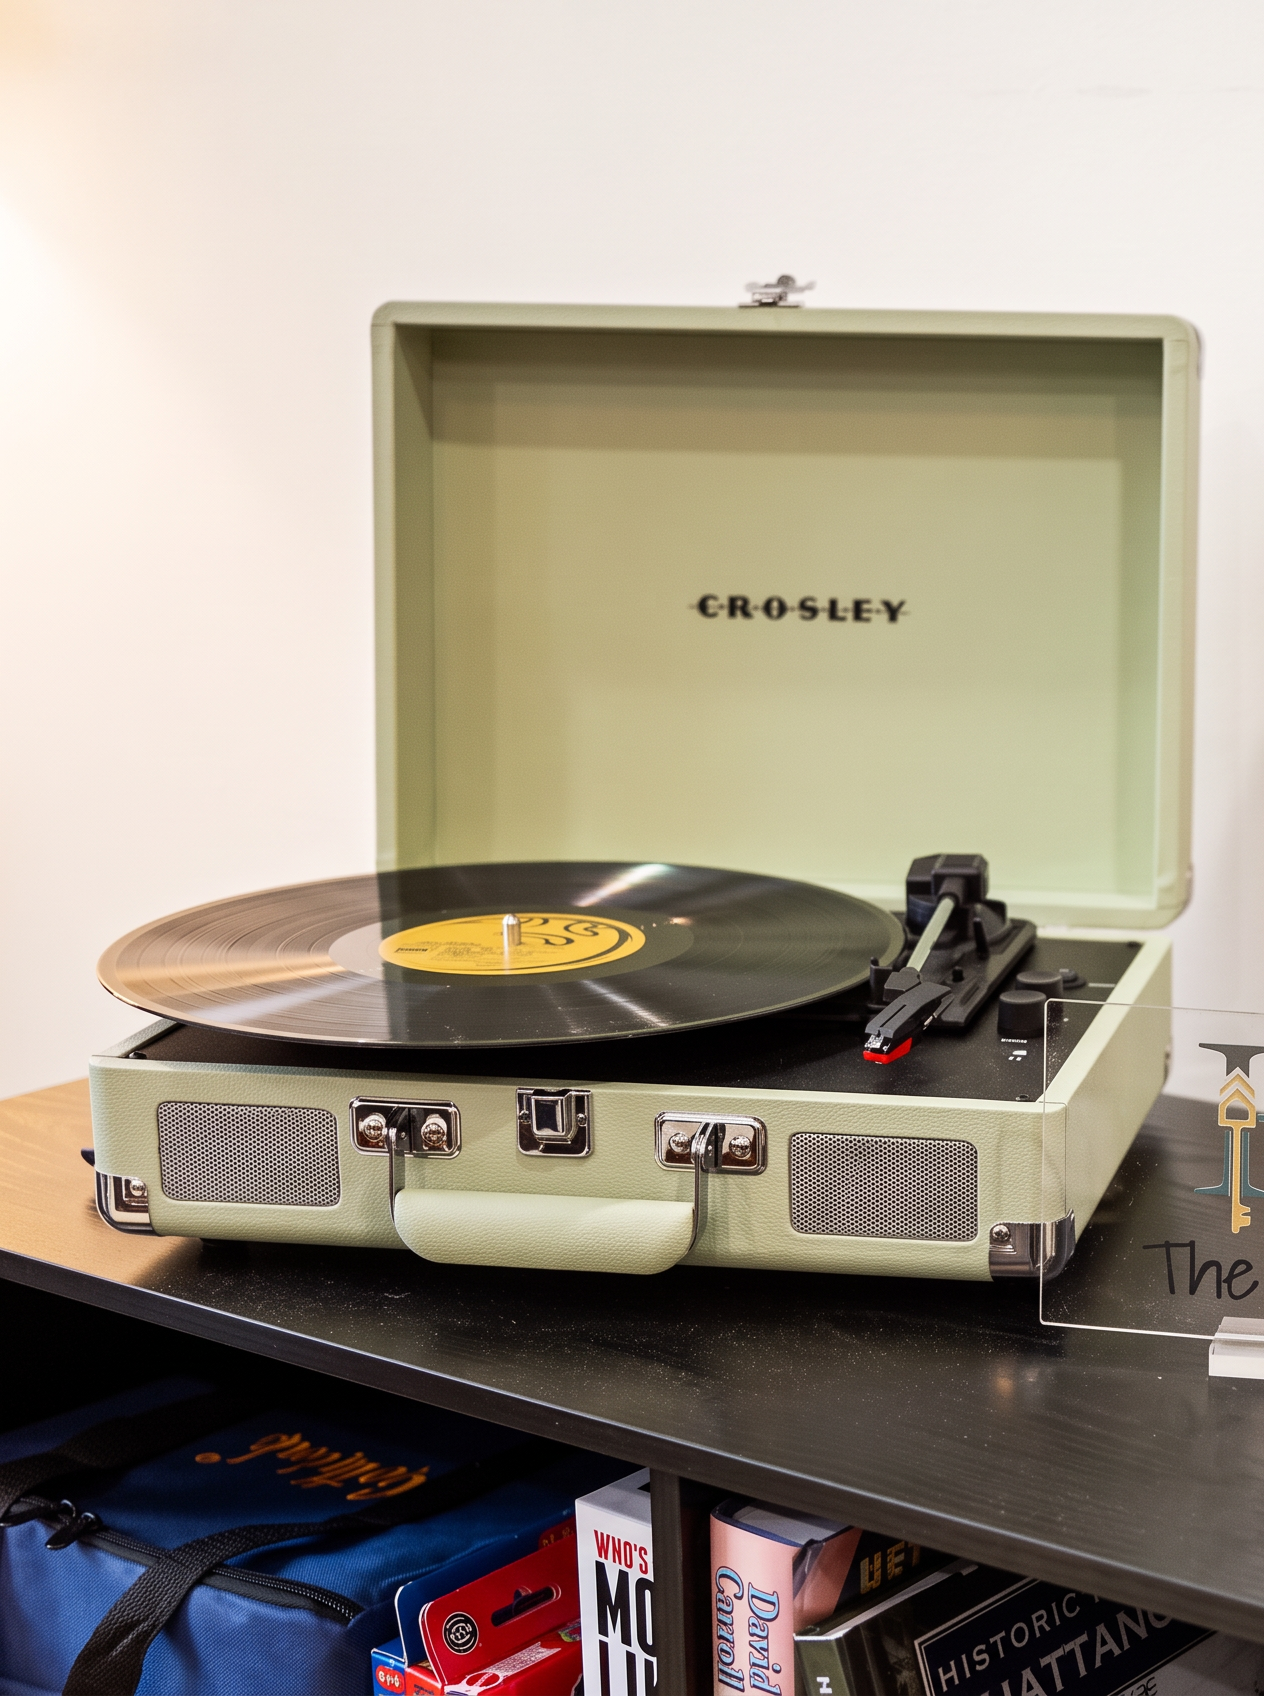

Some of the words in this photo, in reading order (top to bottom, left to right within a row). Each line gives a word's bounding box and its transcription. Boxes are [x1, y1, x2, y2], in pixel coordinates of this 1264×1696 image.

[697, 594, 906, 624] CROSLEY
[1143, 1239, 1259, 1300] The
[715, 1566, 745, 1693] Carroll
[747, 1582, 782, 1696] David
[938, 1592, 1081, 1693] HISTORIC
[982, 1604, 1173, 1696] ATTAN
